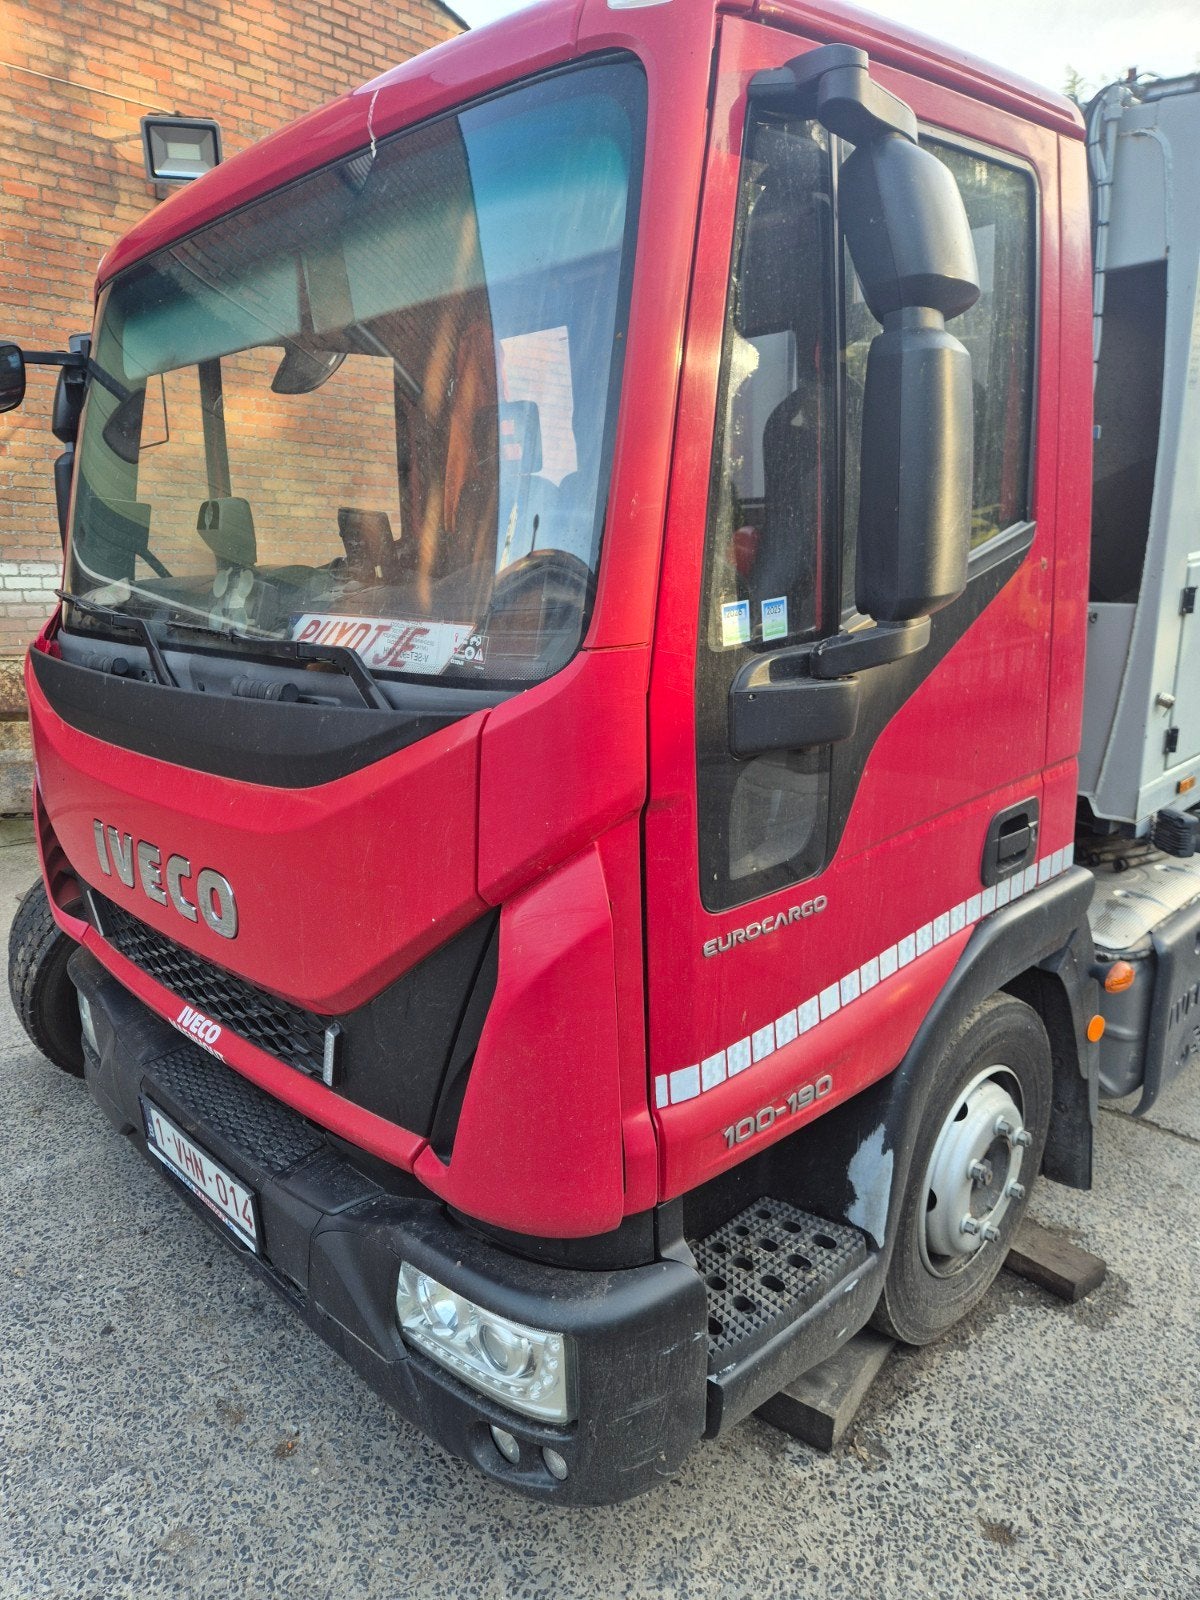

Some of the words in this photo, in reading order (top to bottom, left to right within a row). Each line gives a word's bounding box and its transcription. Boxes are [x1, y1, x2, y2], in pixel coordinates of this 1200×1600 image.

[93, 818, 240, 940] IVECO
[703, 895, 828, 958] EUROCARGO
[176, 1005, 222, 1044] IVECO
[723, 1074, 833, 1149] 100-190
[156, 1117, 253, 1229] 1-VHN-014
